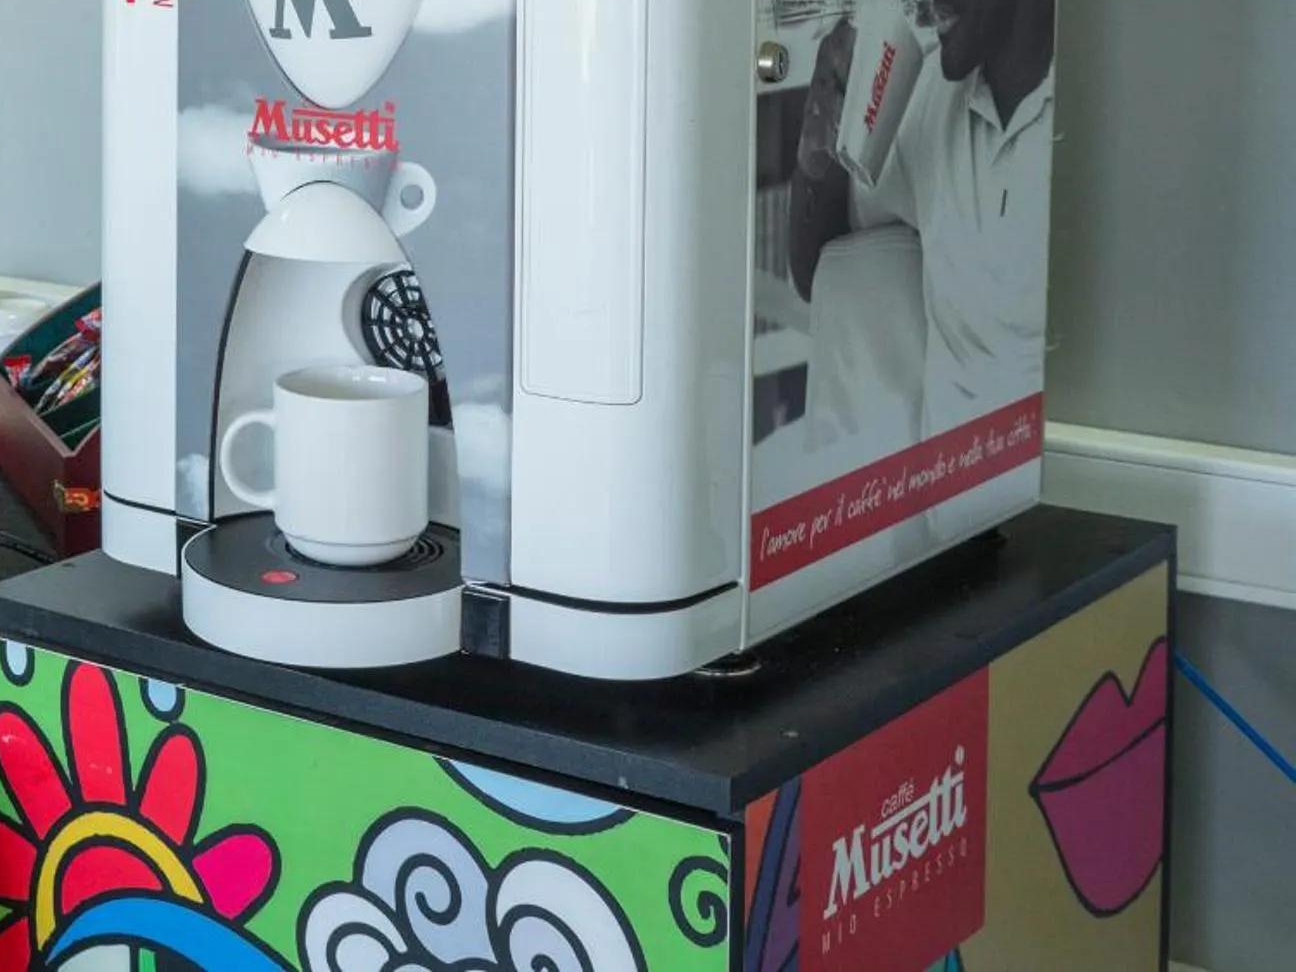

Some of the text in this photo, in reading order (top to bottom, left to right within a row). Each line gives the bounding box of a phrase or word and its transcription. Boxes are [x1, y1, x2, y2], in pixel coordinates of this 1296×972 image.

[248, 98, 400, 153] Musetti
[809, 508, 832, 549] per
[823, 744, 967, 920] Musetti
[822, 837, 967, 954] MIO ESPRESSO
